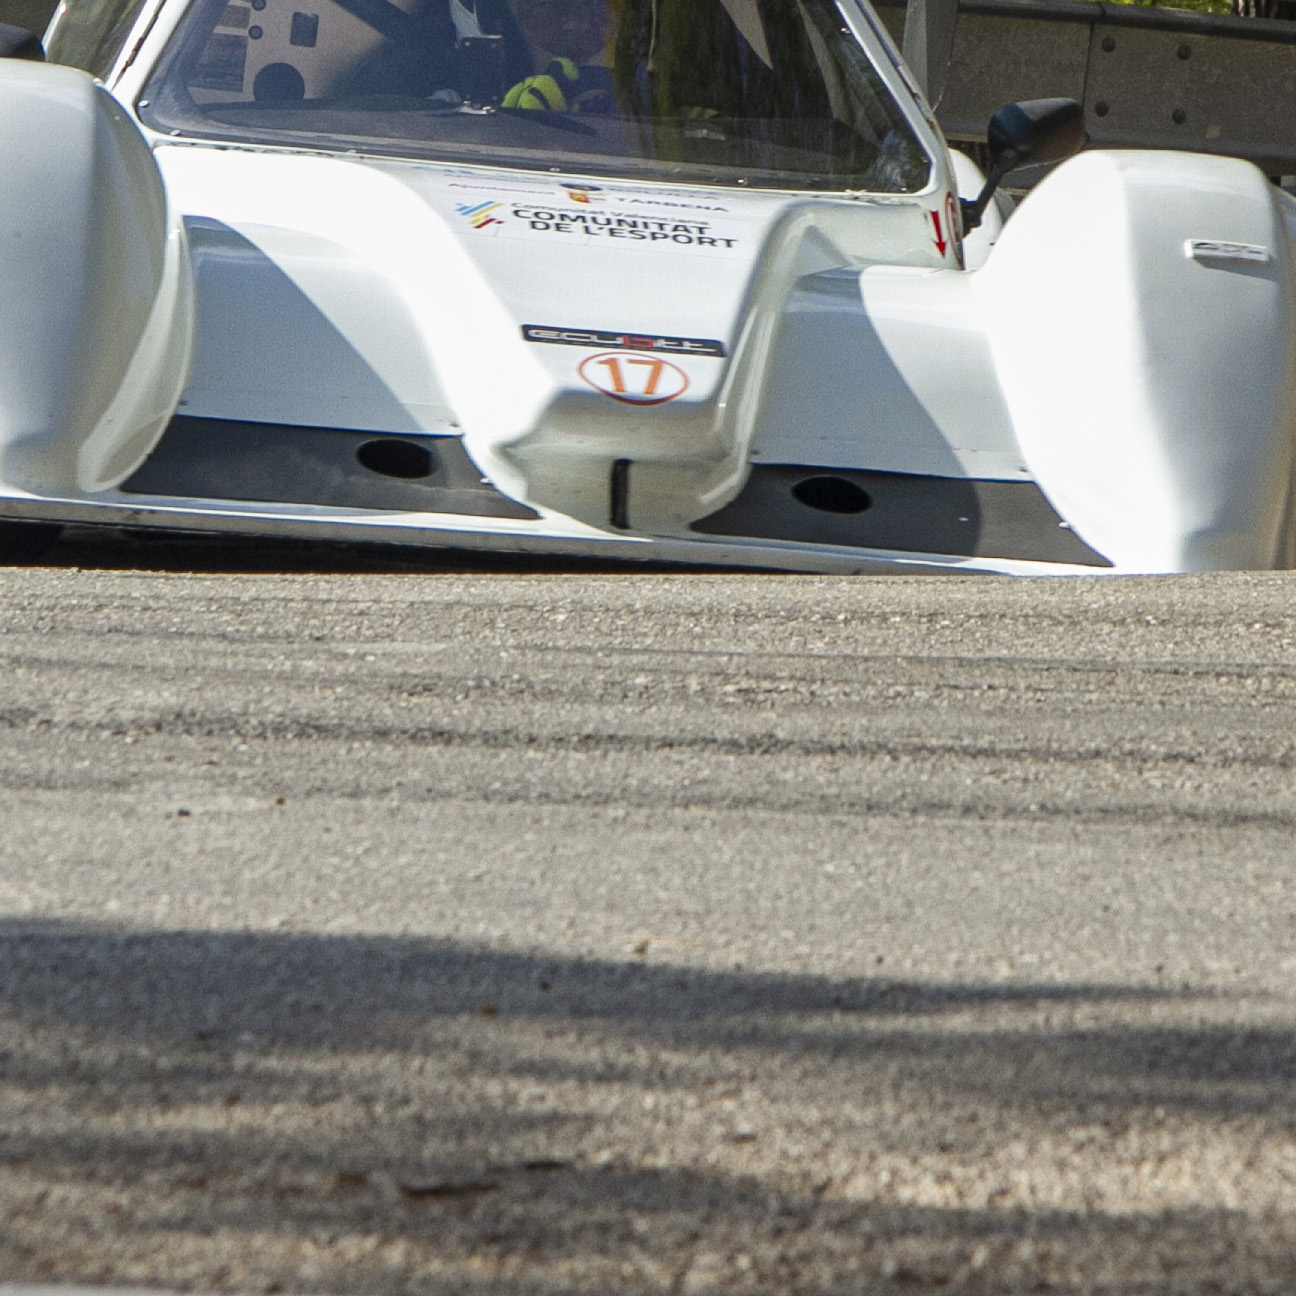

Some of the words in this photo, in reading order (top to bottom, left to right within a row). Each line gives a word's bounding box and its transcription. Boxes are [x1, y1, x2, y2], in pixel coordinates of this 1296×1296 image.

[513, 209, 710, 235] COMUNITAT
[530, 220, 573, 233] DE
[583, 225, 739, 248] L'ESPORT
[597, 358, 664, 395] 17
